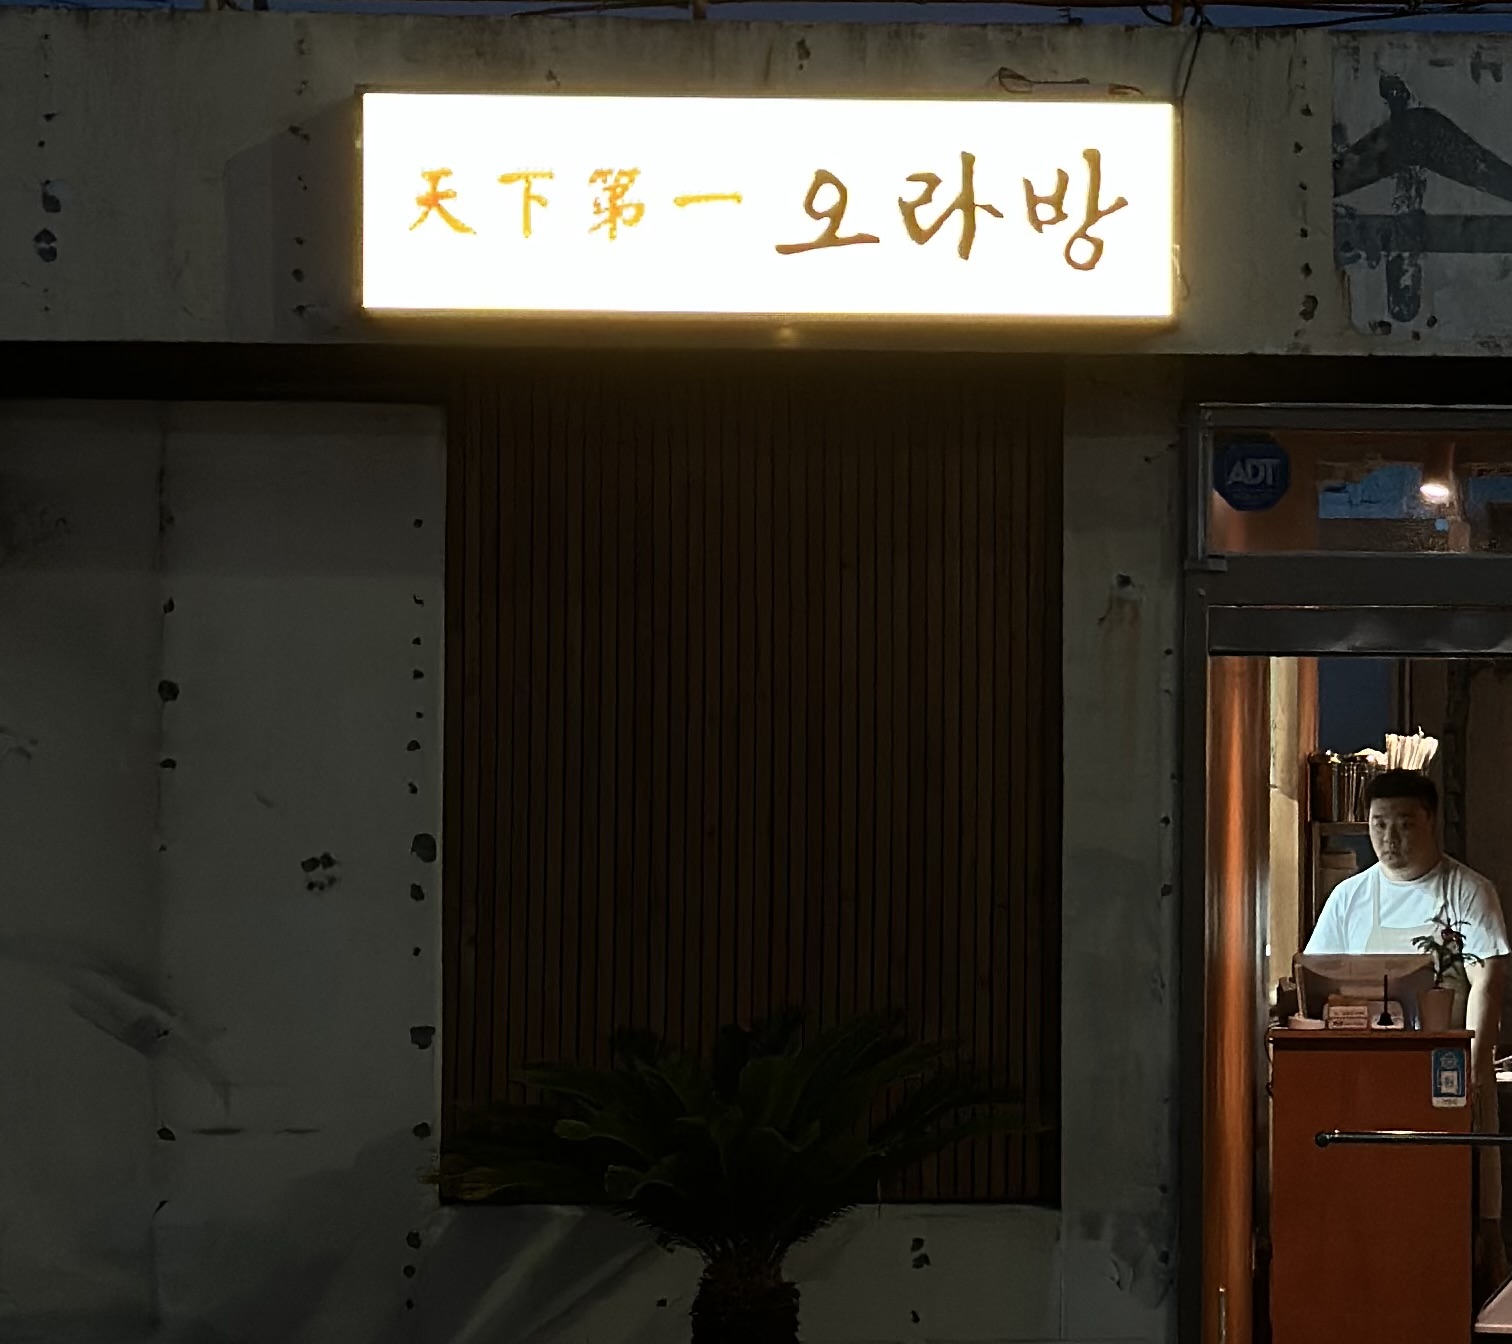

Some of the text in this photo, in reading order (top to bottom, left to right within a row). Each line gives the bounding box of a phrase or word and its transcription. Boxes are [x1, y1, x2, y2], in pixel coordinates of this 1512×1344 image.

[410, 148, 1129, 272] 天下第一 오라방
[1225, 458, 1282, 486] ADT
